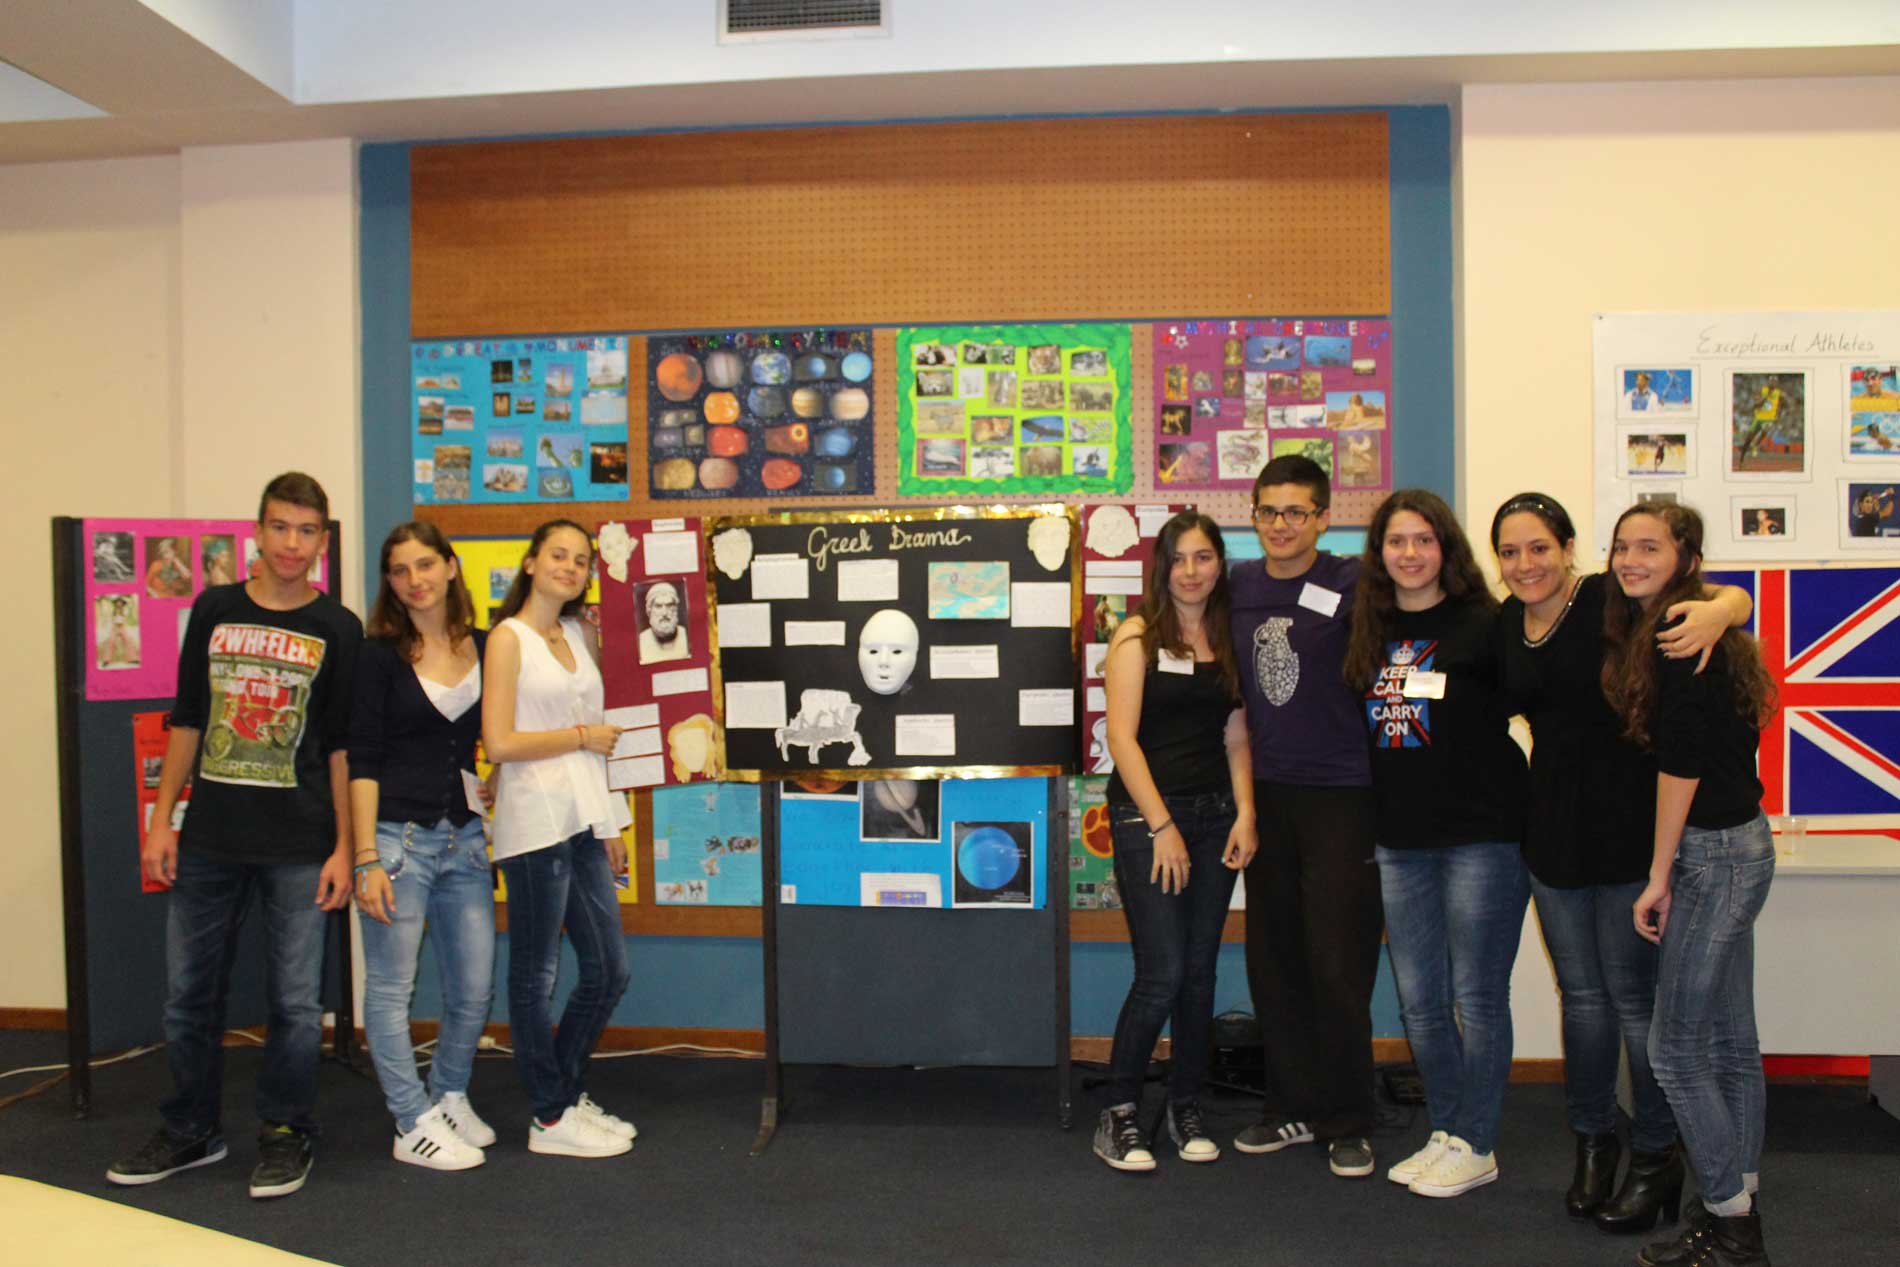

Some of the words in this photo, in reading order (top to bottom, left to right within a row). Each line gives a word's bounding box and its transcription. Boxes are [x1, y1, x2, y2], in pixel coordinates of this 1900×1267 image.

[1695, 324, 1799, 358] Exceptional
[1806, 330, 1875, 354] Athletes
[807, 525, 873, 572] Greek
[888, 524, 973, 551] Drama
[1374, 681, 1404, 695] CAL
[1386, 696, 1403, 704] AND
[1371, 705, 1423, 721] CARRY
[1385, 721, 1408, 736] ON
